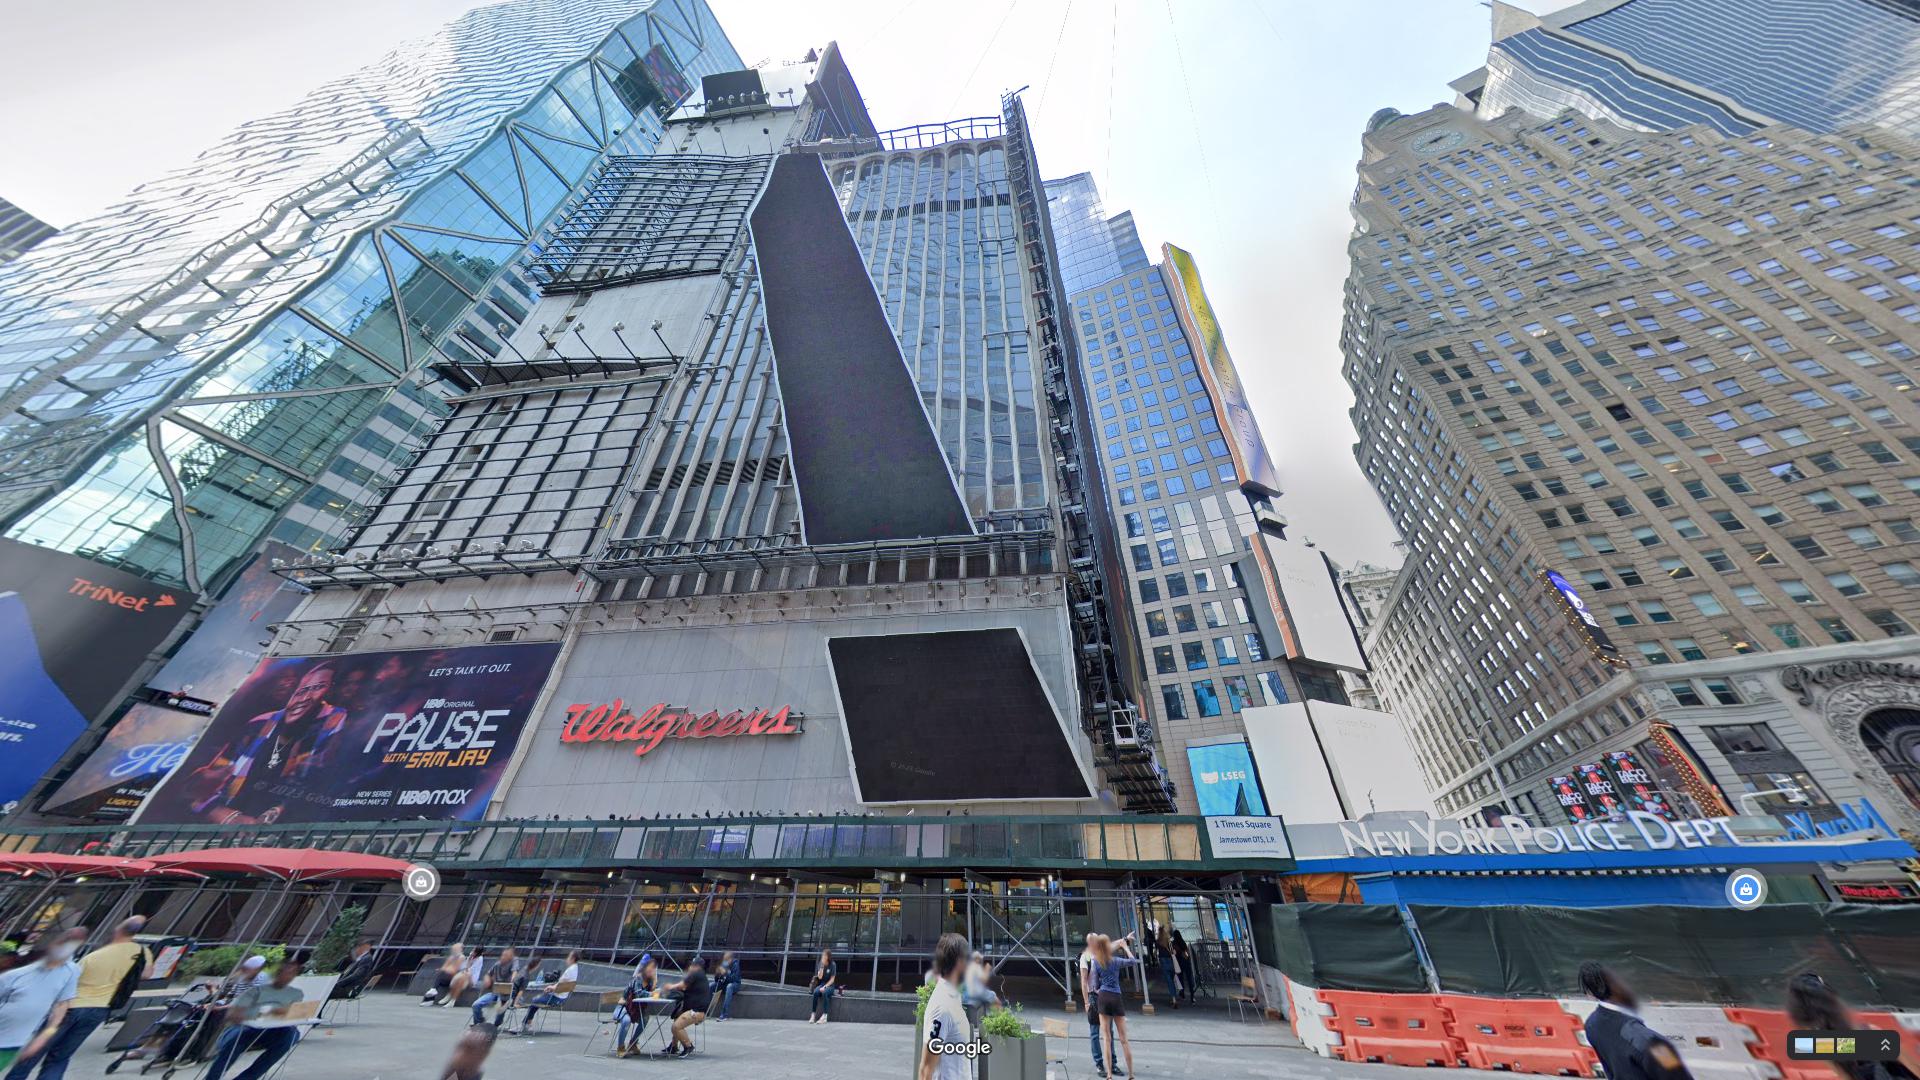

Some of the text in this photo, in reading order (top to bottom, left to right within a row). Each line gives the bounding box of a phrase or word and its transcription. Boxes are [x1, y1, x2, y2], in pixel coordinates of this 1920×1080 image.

[68, 578, 149, 612] TriNet
[429, 663, 512, 677] LET'S TALK IT OUT.
[424, 698, 475, 709] HBO ORIGINAL
[363, 709, 511, 753] PAUSE
[562, 698, 798, 757] Walgreens
[382, 749, 492, 768] WITH SAM JAY
[1221, 770, 1246, 781] LSEG
[1616, 768, 1646, 778] TACO
[1621, 774, 1651, 783] BELL
[1585, 780, 1612, 791] TACO
[1589, 786, 1615, 795] BELL
[372, 790, 392, 798] SERIES
[1557, 791, 1583, 802] TACO
[333, 798, 366, 807] STREAMING
[1560, 797, 1585, 806] BELL
[1215, 820, 1272, 829] 1 Times Square
[1219, 836, 1252, 844] Jamestown
